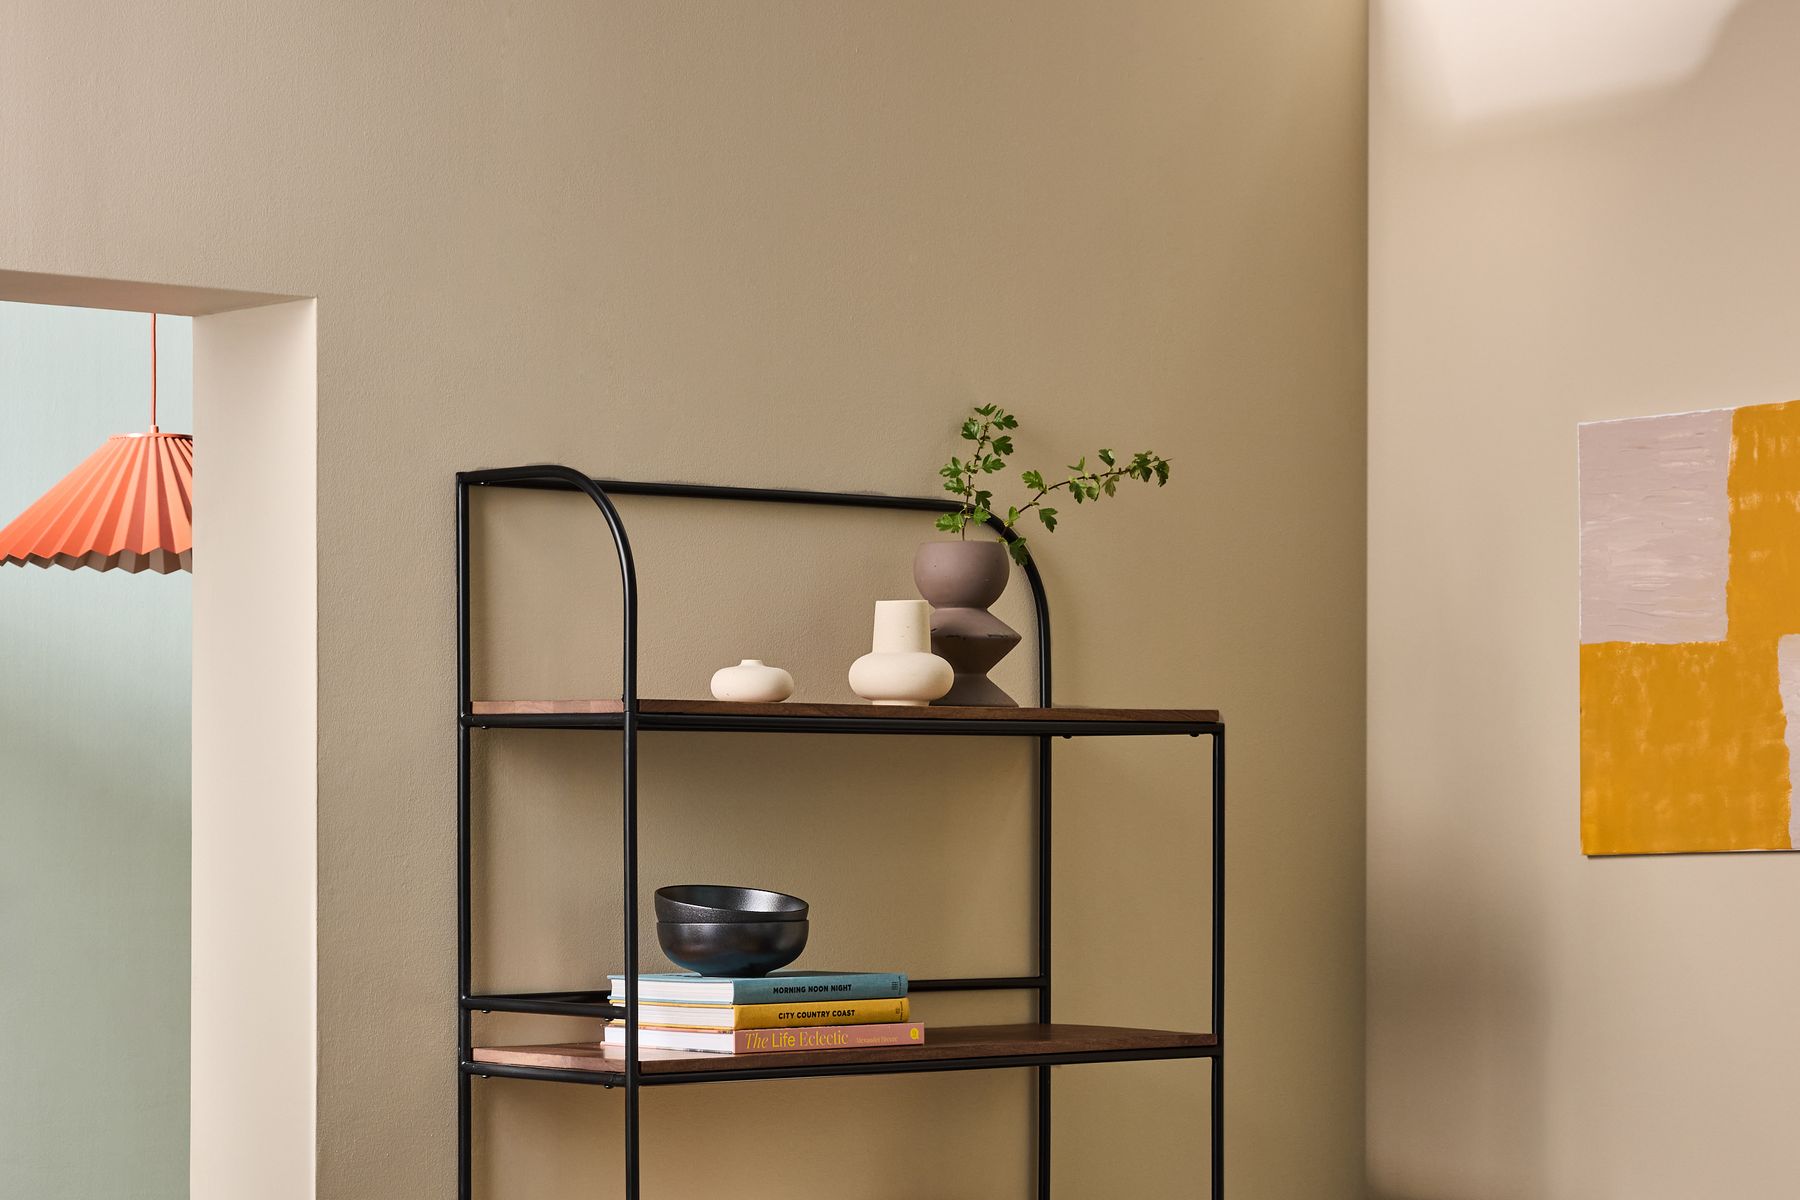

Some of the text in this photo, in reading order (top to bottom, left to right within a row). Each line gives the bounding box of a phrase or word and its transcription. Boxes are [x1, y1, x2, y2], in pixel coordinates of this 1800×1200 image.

[773, 984, 852, 994] MORNING NOON NIGHT
[778, 1009, 855, 1020] CITY COUNTRY COAST
[745, 1030, 849, 1049] The Life Eclectic
